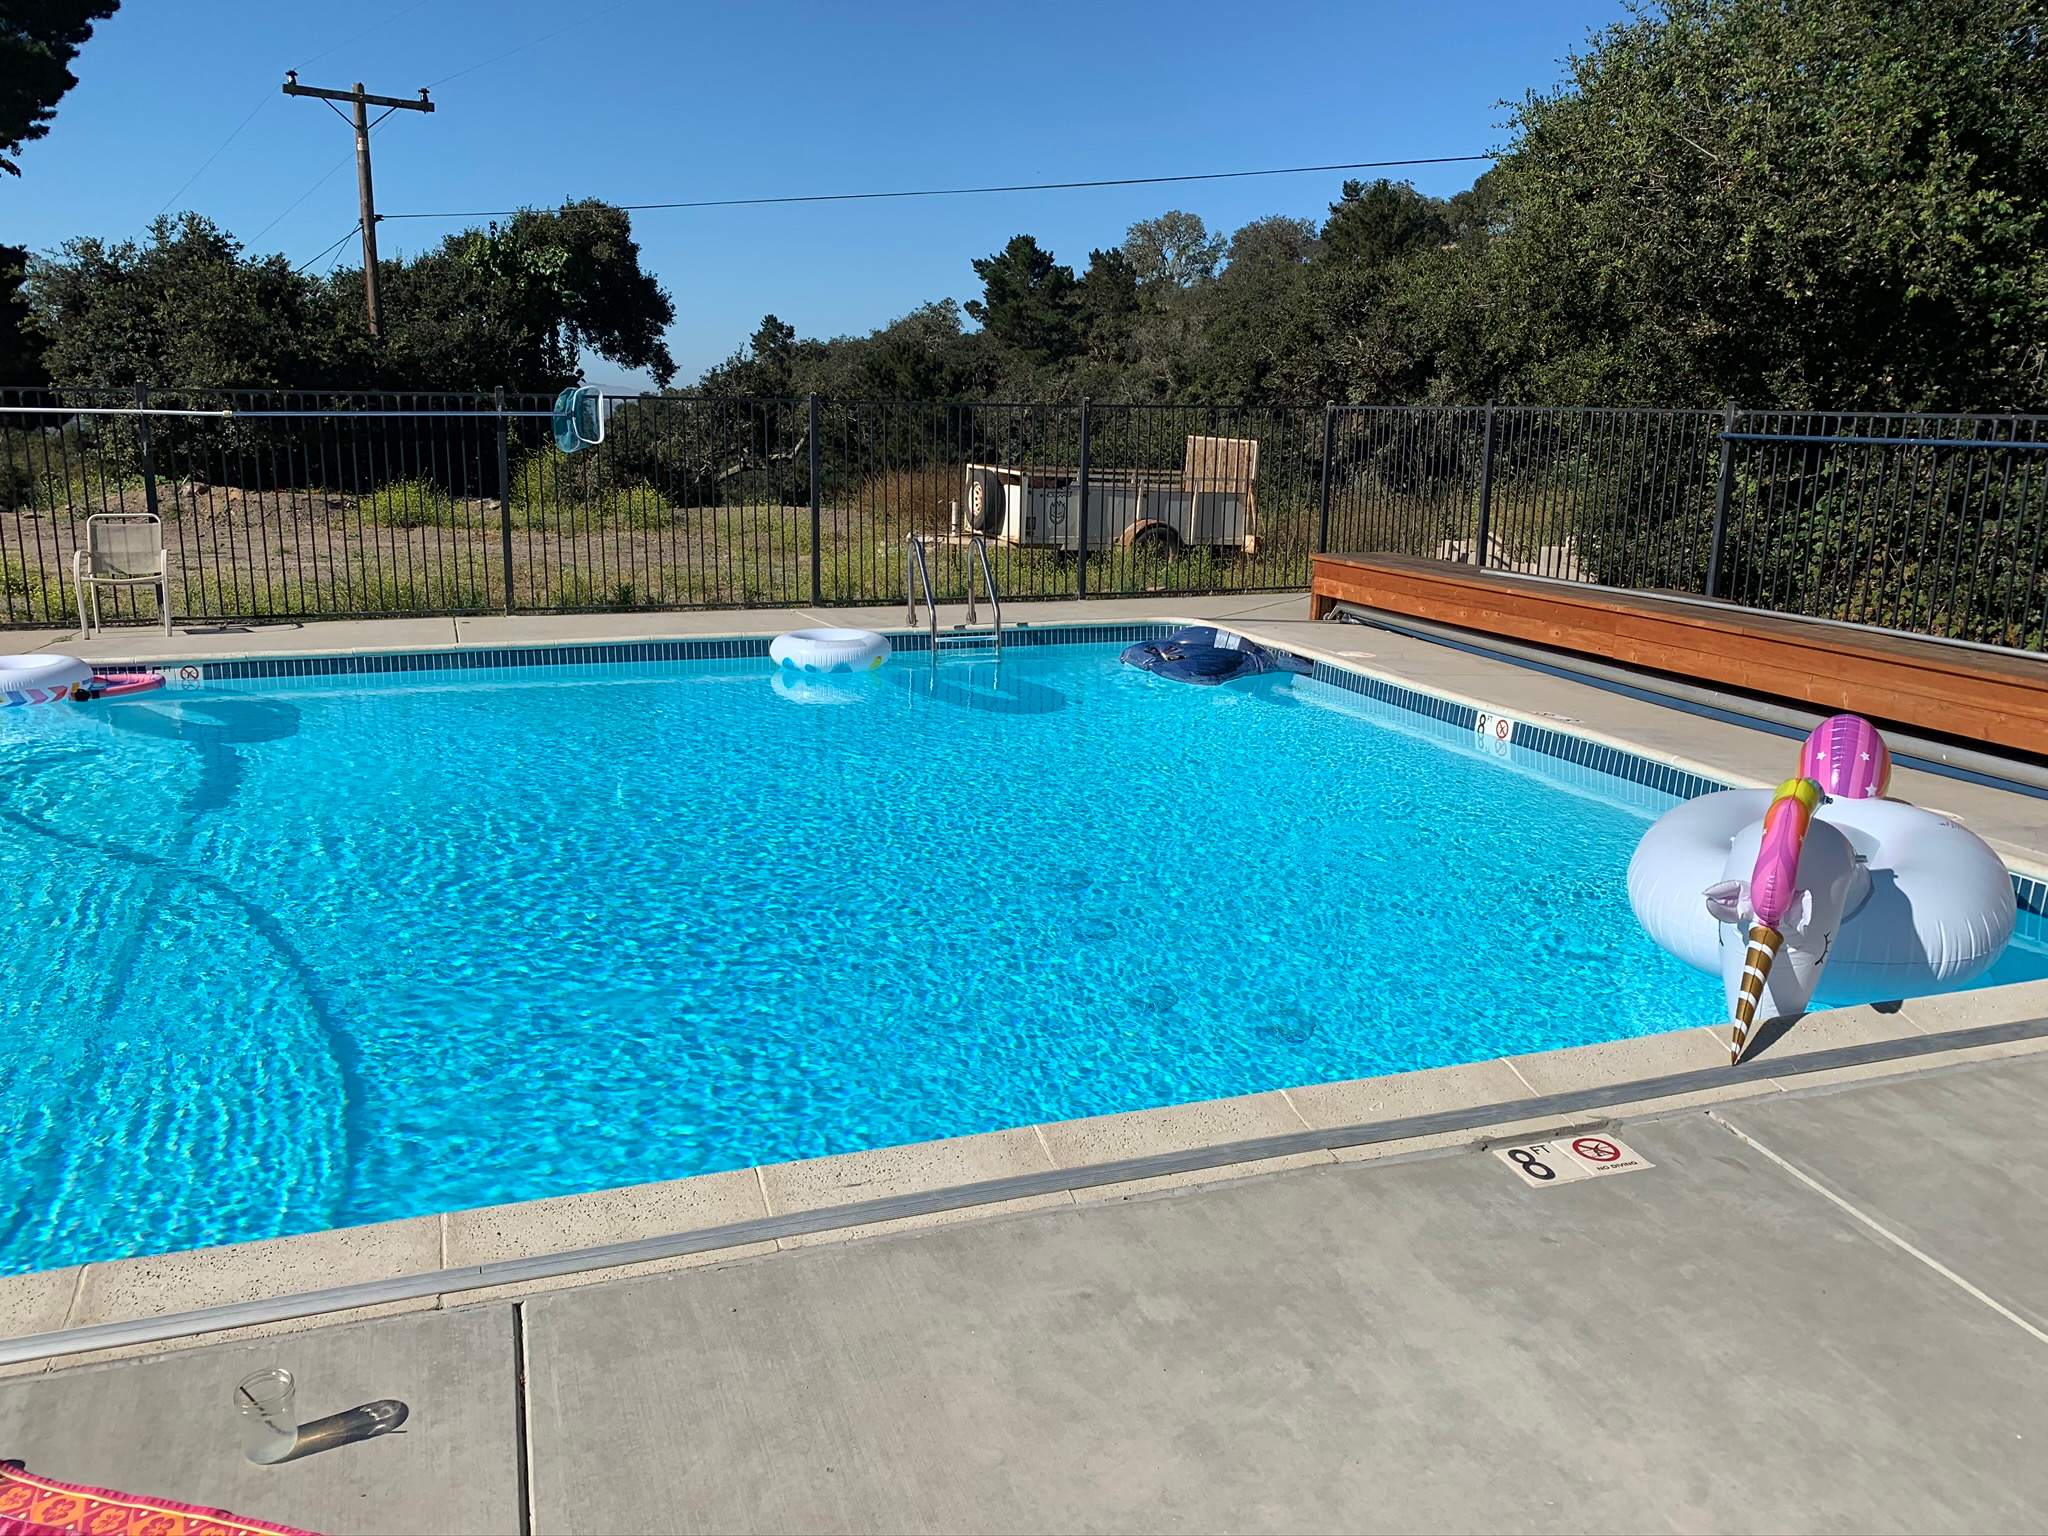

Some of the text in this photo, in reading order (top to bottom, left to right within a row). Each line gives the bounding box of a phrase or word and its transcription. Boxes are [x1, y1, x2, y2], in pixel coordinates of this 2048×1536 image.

[1477, 714, 1486, 735] 8
[1507, 1144, 1556, 1180] 8 FT
[1610, 1160, 1639, 1169] DIVING
